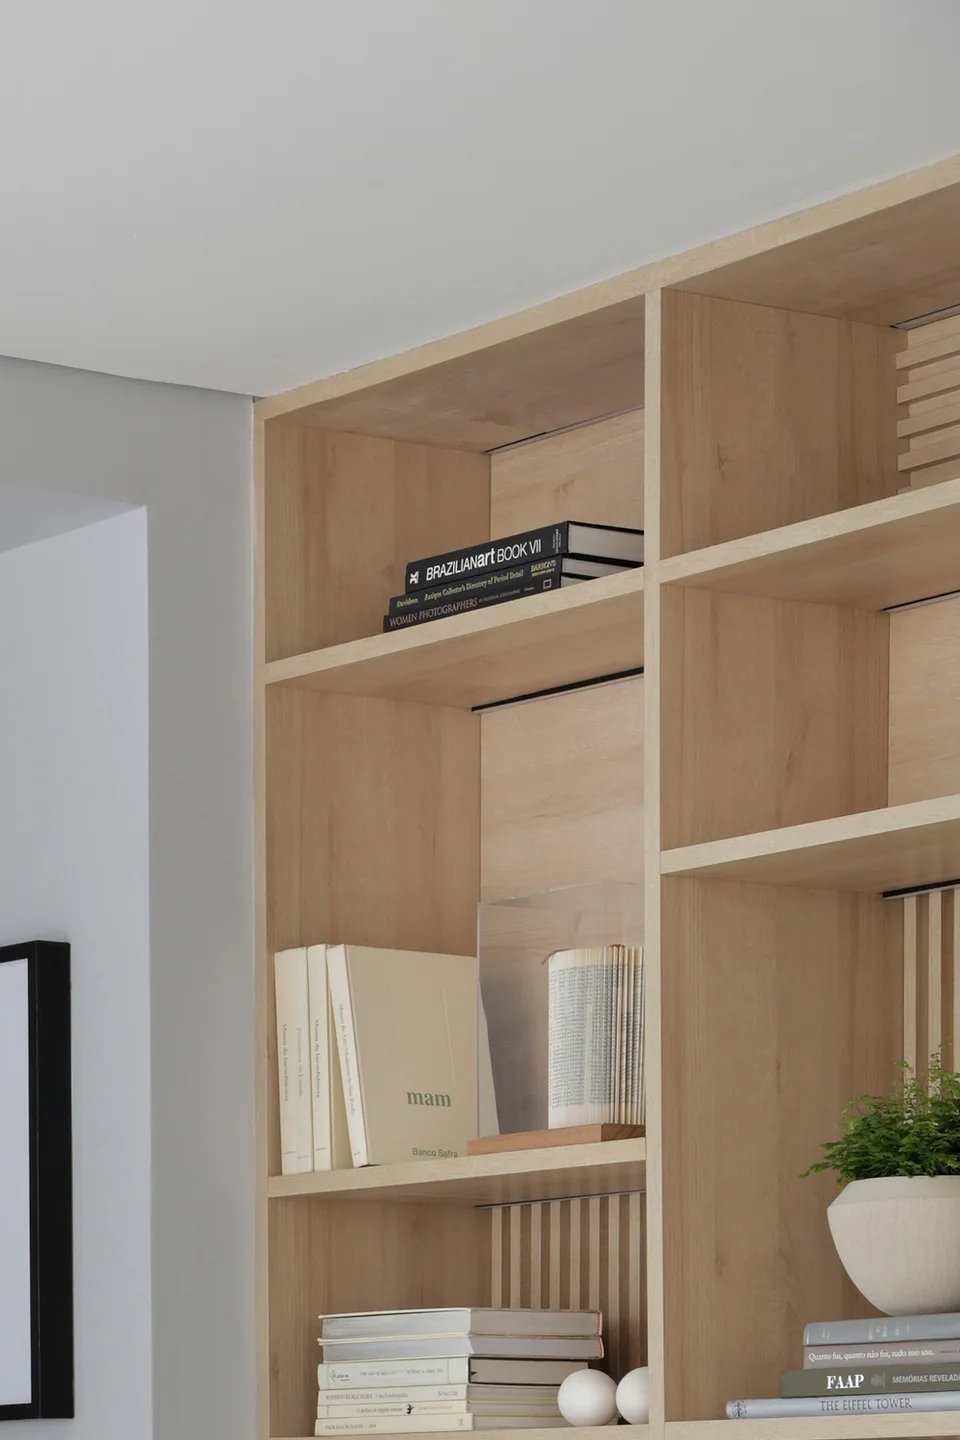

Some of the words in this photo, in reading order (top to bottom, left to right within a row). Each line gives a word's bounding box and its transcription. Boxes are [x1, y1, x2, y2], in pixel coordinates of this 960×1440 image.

[426, 547, 496, 581] BRAZILIANart
[497, 541, 527, 563] BOOK
[529, 538, 542, 554] VII
[466, 579, 488, 591] Directory
[494, 572, 510, 583] Period
[510, 569, 524, 580] Detail
[389, 612, 418, 627] WOMEN
[419, 597, 478, 620] PHOTOGRAPHERS
[406, 1092, 452, 1107] mam
[412, 1147, 437, 1157] Banco
[437, 1148, 459, 1158] Safra
[808, 1352, 832, 1363] Quanto
[832, 1351, 843, 1361] fui,
[843, 1351, 866, 1361] quanto
[867, 1350, 879, 1359] não
[880, 1348, 891, 1359] fui,
[891, 1348, 907, 1357] tudo
[907, 1348, 920, 1357] isso
[826, 1373, 865, 1390] FAAP
[892, 1374, 928, 1384] MEMÓRIAS
[820, 1399, 840, 1411] THE
[843, 1399, 874, 1411] EIFFEL
[876, 1398, 913, 1410] TOWER
